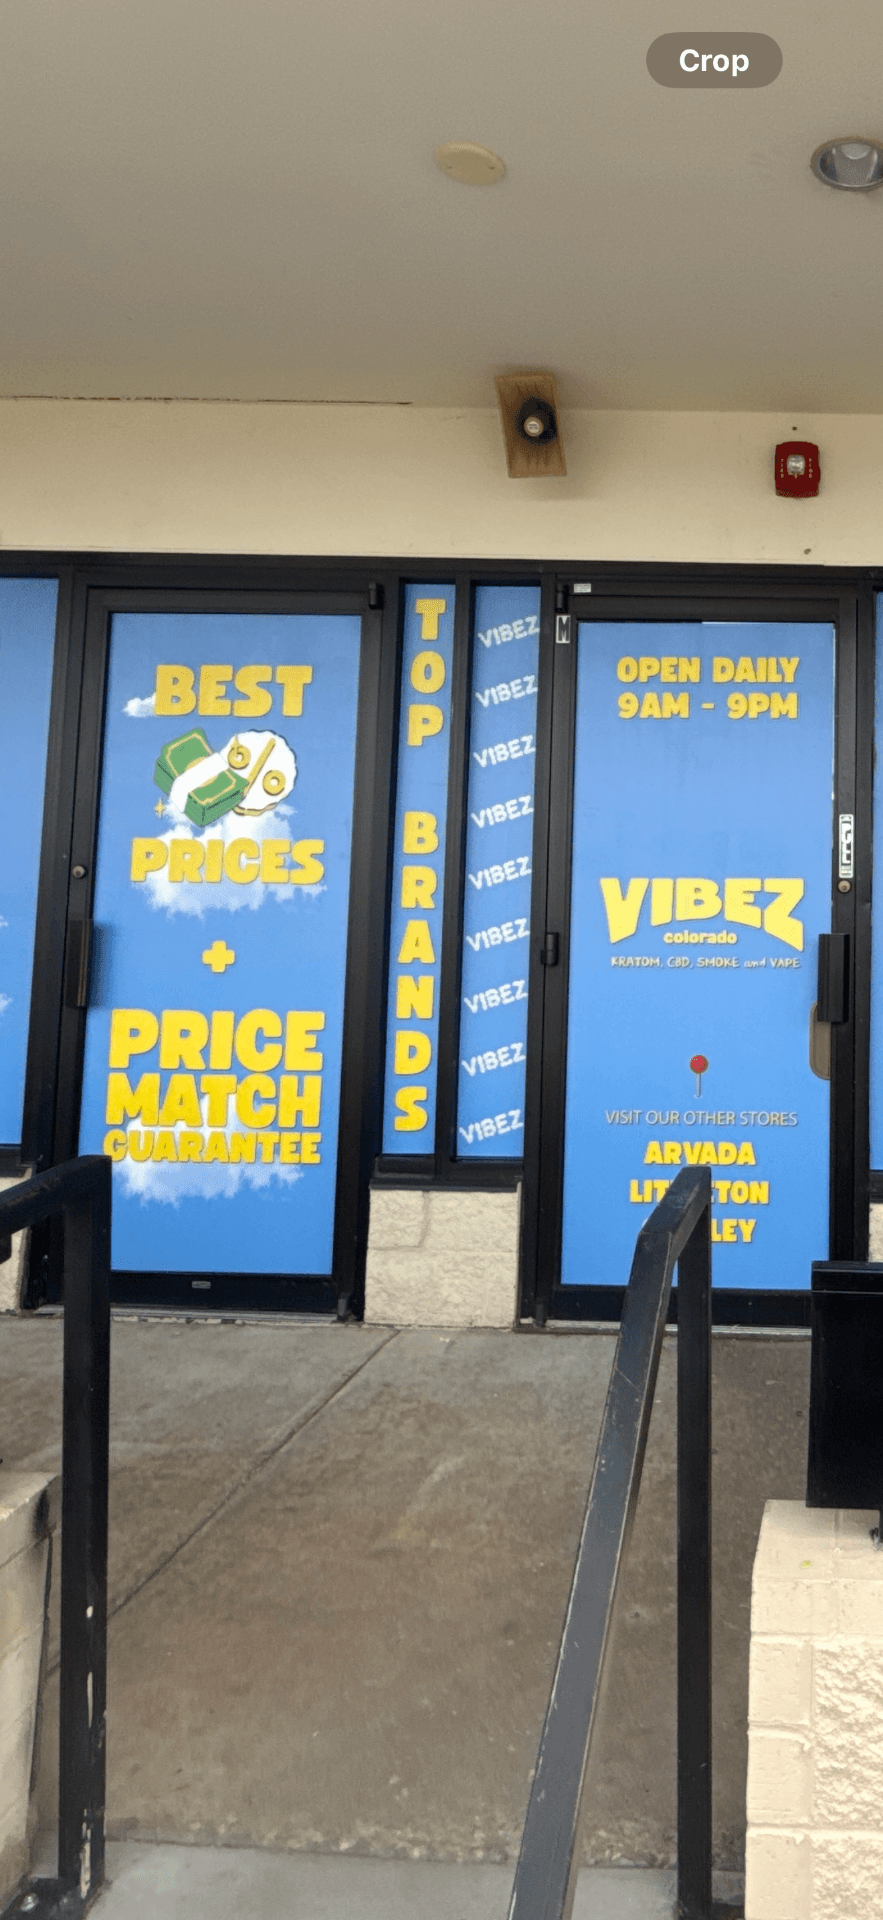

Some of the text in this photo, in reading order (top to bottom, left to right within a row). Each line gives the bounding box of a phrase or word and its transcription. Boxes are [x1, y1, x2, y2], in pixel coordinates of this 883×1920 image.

[478, 616, 540, 648] VIBEZ
[407, 598, 446, 746] TOP
[617, 656, 799, 683] OPEN DAILY
[154, 664, 313, 718] BEST
[475, 675, 538, 708] VIBEZ
[617, 692, 690, 719] 9AM
[727, 692, 798, 719] 9PM
[473, 735, 536, 768] VIBEZ
[470, 796, 534, 829] VIBEZ
[130, 838, 325, 885] PRICES
[468, 857, 532, 890] VIBEZ
[600, 877, 805, 952] VIBEZ
[466, 918, 530, 951] VIBEZ
[663, 930, 738, 945] colorado
[393, 811, 439, 1132] BRANDS
[611, 956, 800, 969] KRATOM, CBD, SMOKE and VAPE
[463, 980, 528, 1014] VIBEZ
[108, 1008, 325, 1072] PRICE
[461, 1042, 526, 1077] VIBEZ
[105, 1072, 323, 1129] MATCH
[459, 1109, 524, 1144] VIBEZ
[605, 1110, 798, 1126] VISIT OUR OTHER STORES
[103, 1129, 322, 1165] GUARANTEE
[643, 1141, 756, 1166] ARVADA
[628, 1179, 770, 1205] LITTON
